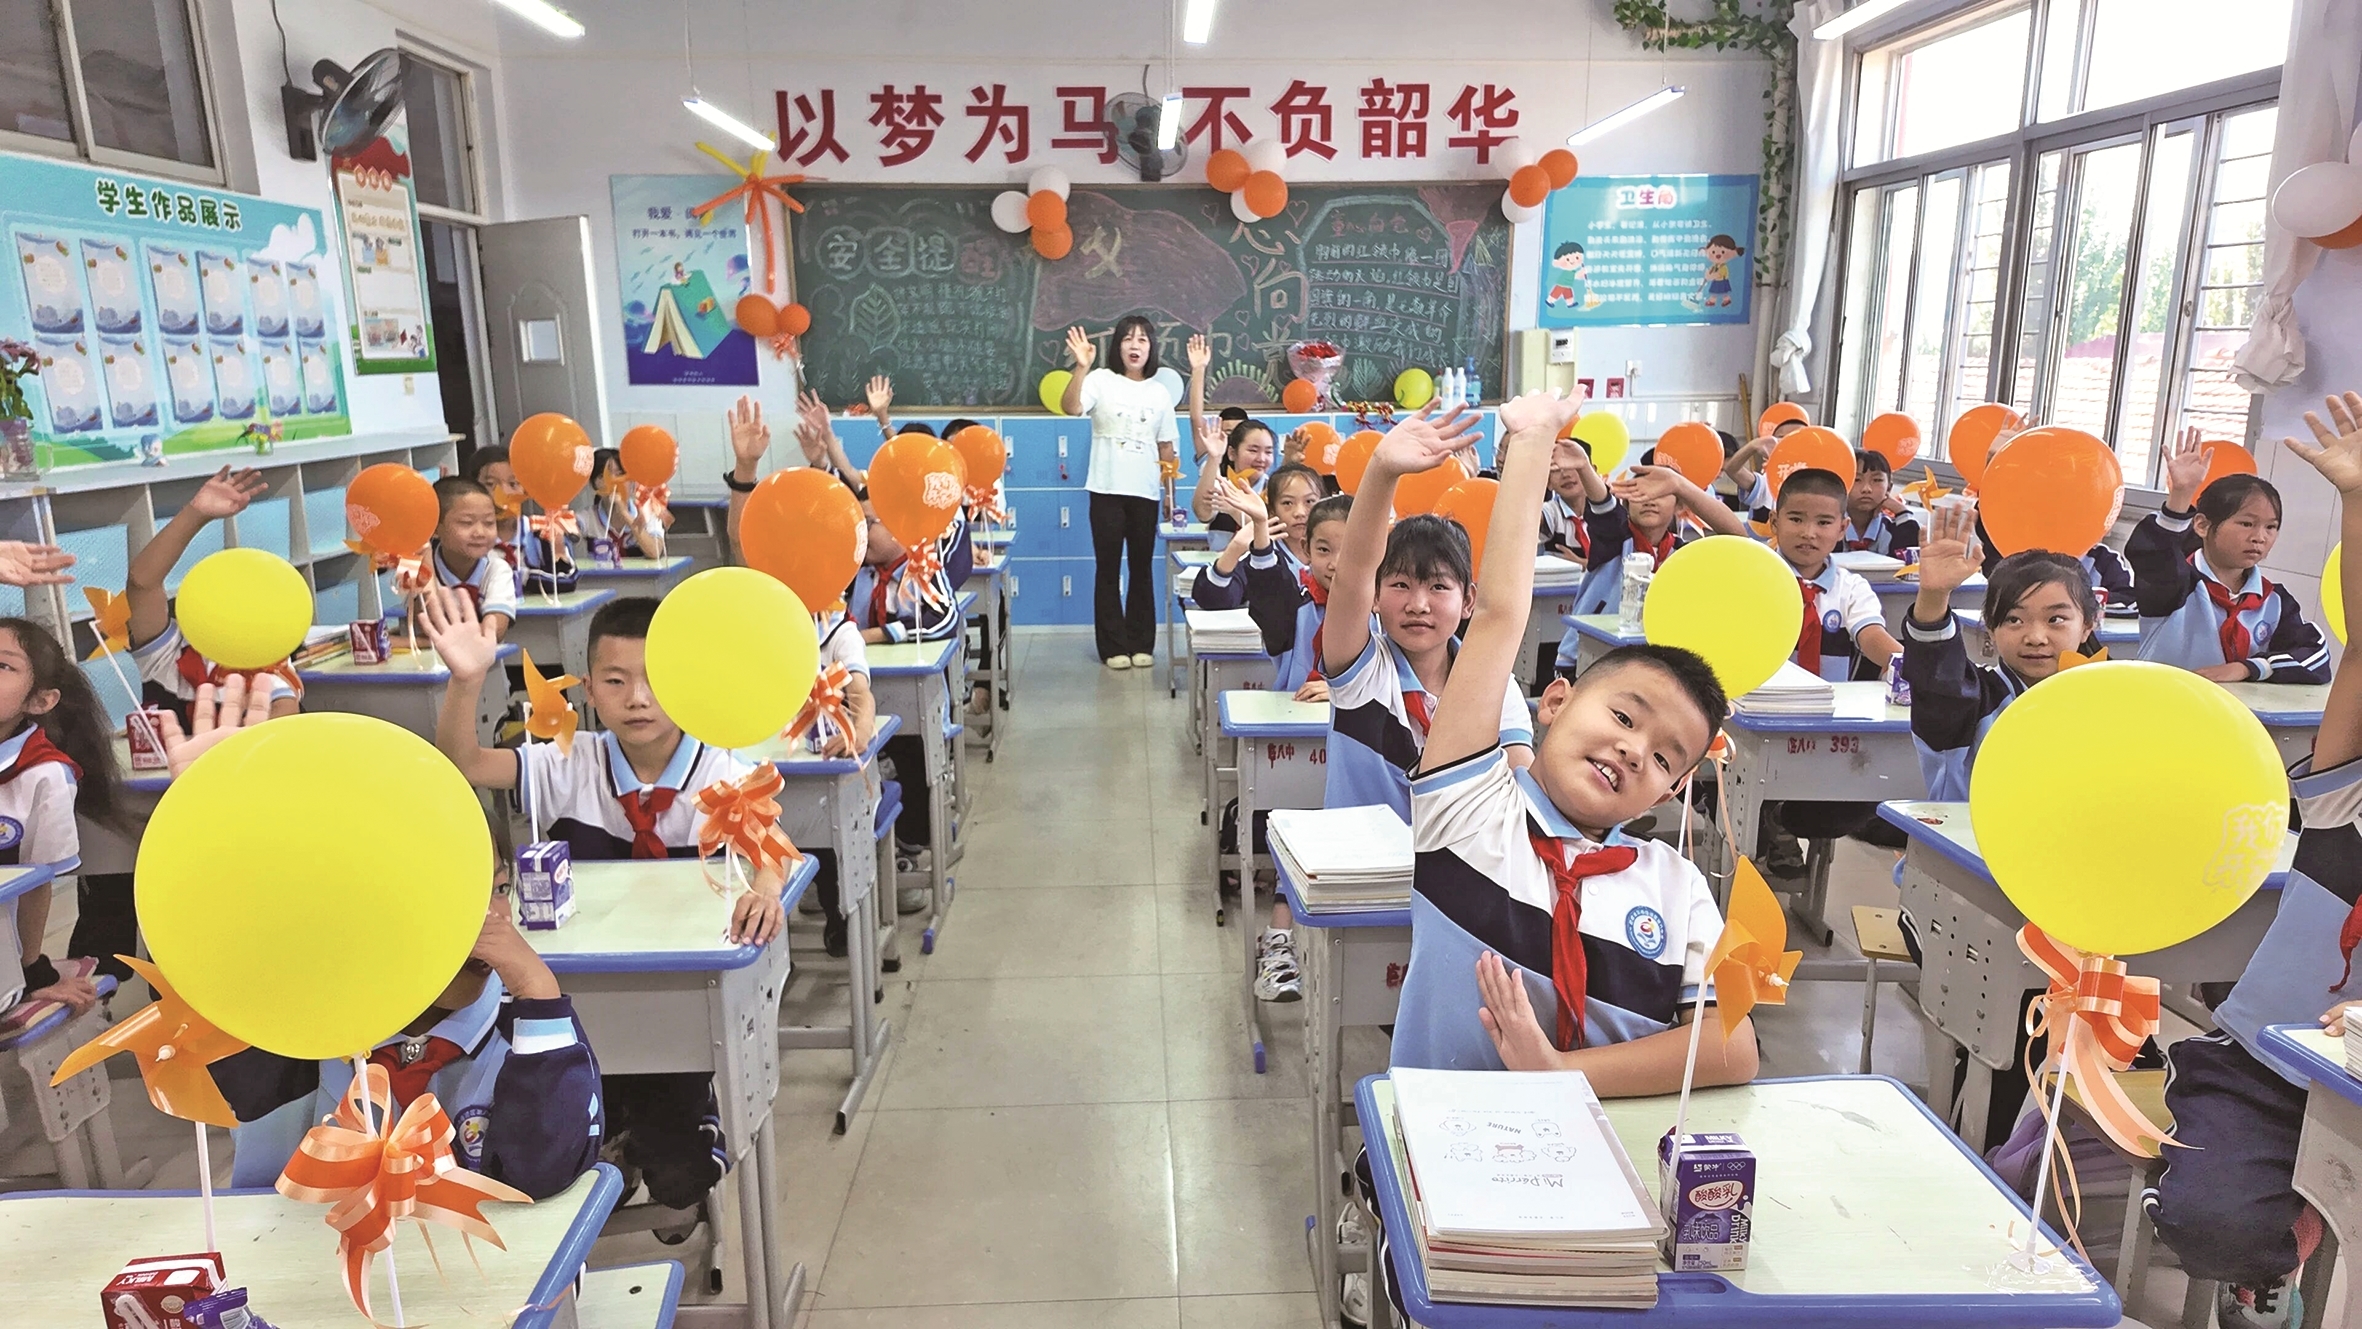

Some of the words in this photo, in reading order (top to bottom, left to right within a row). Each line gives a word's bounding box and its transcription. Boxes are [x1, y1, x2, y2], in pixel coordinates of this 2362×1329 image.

[774, 82, 1119, 166] 以梦为马
[1181, 79, 1523, 165] 不负韶华
[96, 179, 243, 231] 学生作品展示
[1830, 735, 1859, 753] 393
[1486, 1121, 1522, 1135] NATURE
[1694, 1182, 1738, 1202] 酸酸乳
[1730, 1214, 1741, 1244] Drink
[1738, 1218, 1749, 1243] Milky
